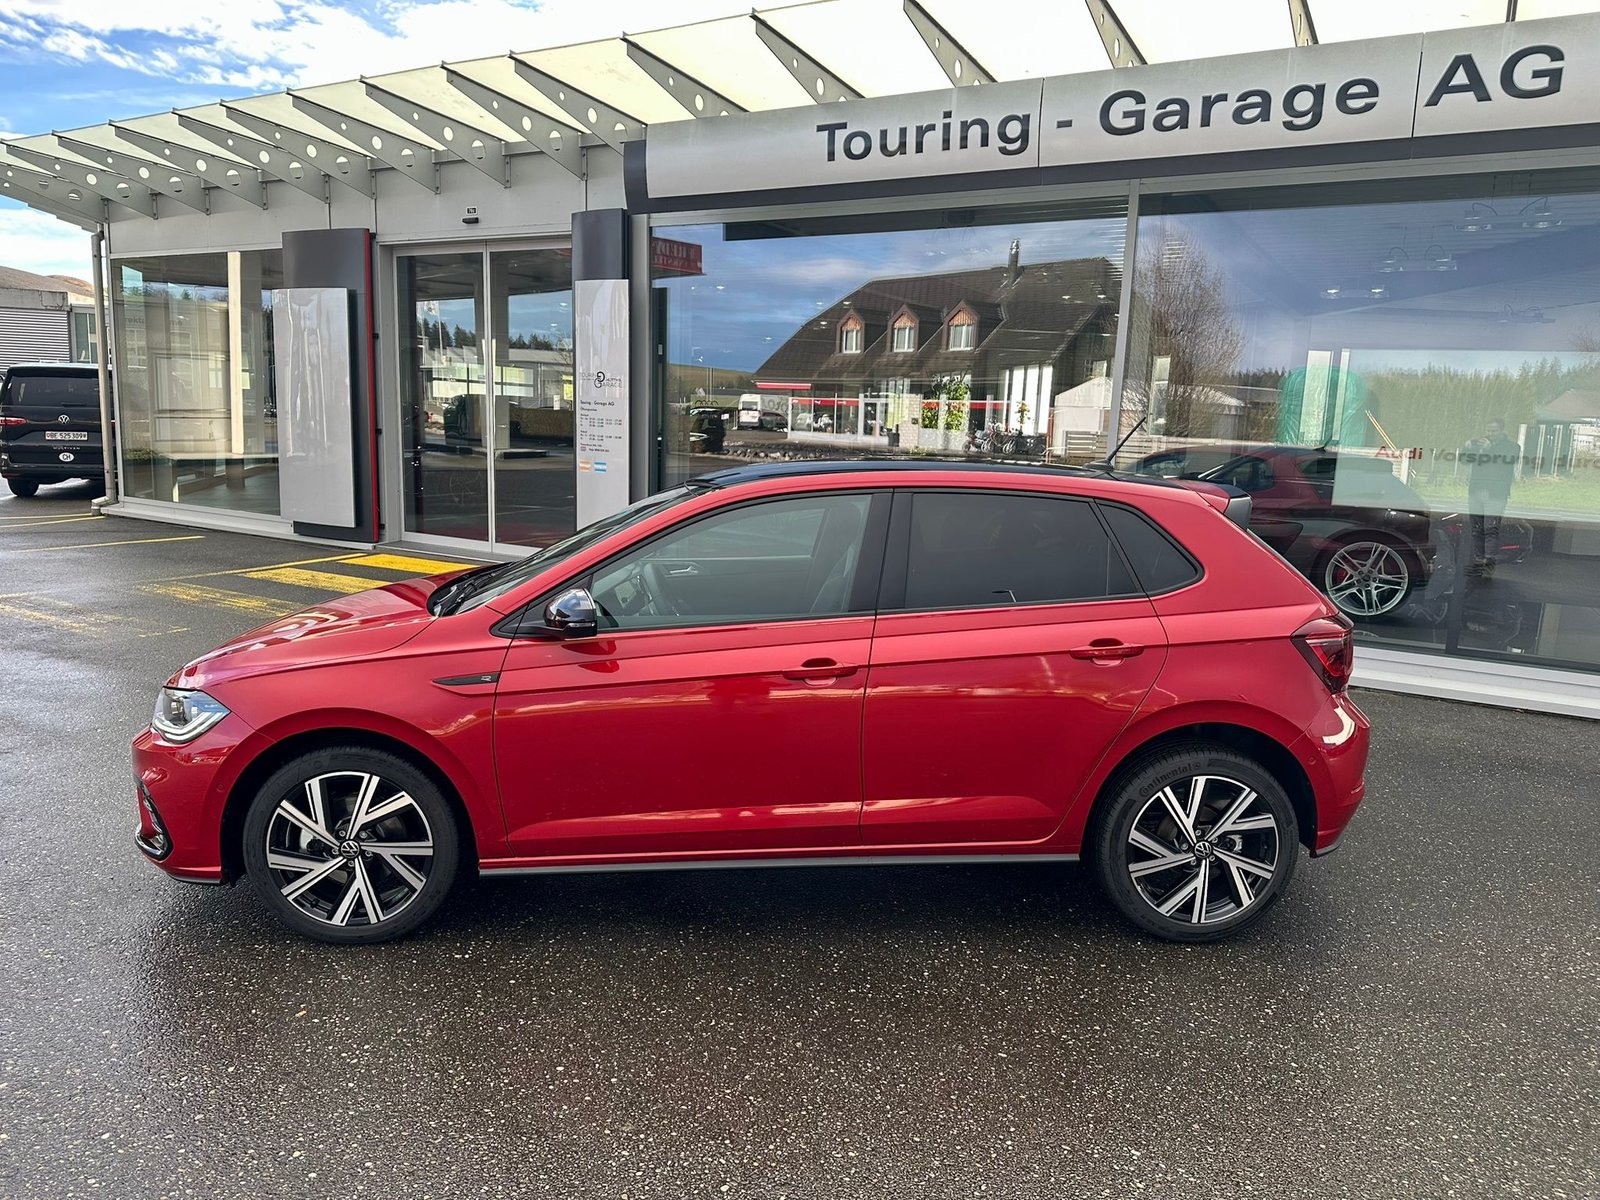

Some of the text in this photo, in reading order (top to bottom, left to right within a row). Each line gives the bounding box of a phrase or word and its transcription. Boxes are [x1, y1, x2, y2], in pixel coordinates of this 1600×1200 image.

[816, 110, 1031, 162] Touring
[1099, 77, 1380, 136] Garage
[1423, 44, 1565, 108] AG
[62, 453, 71, 461] CH
